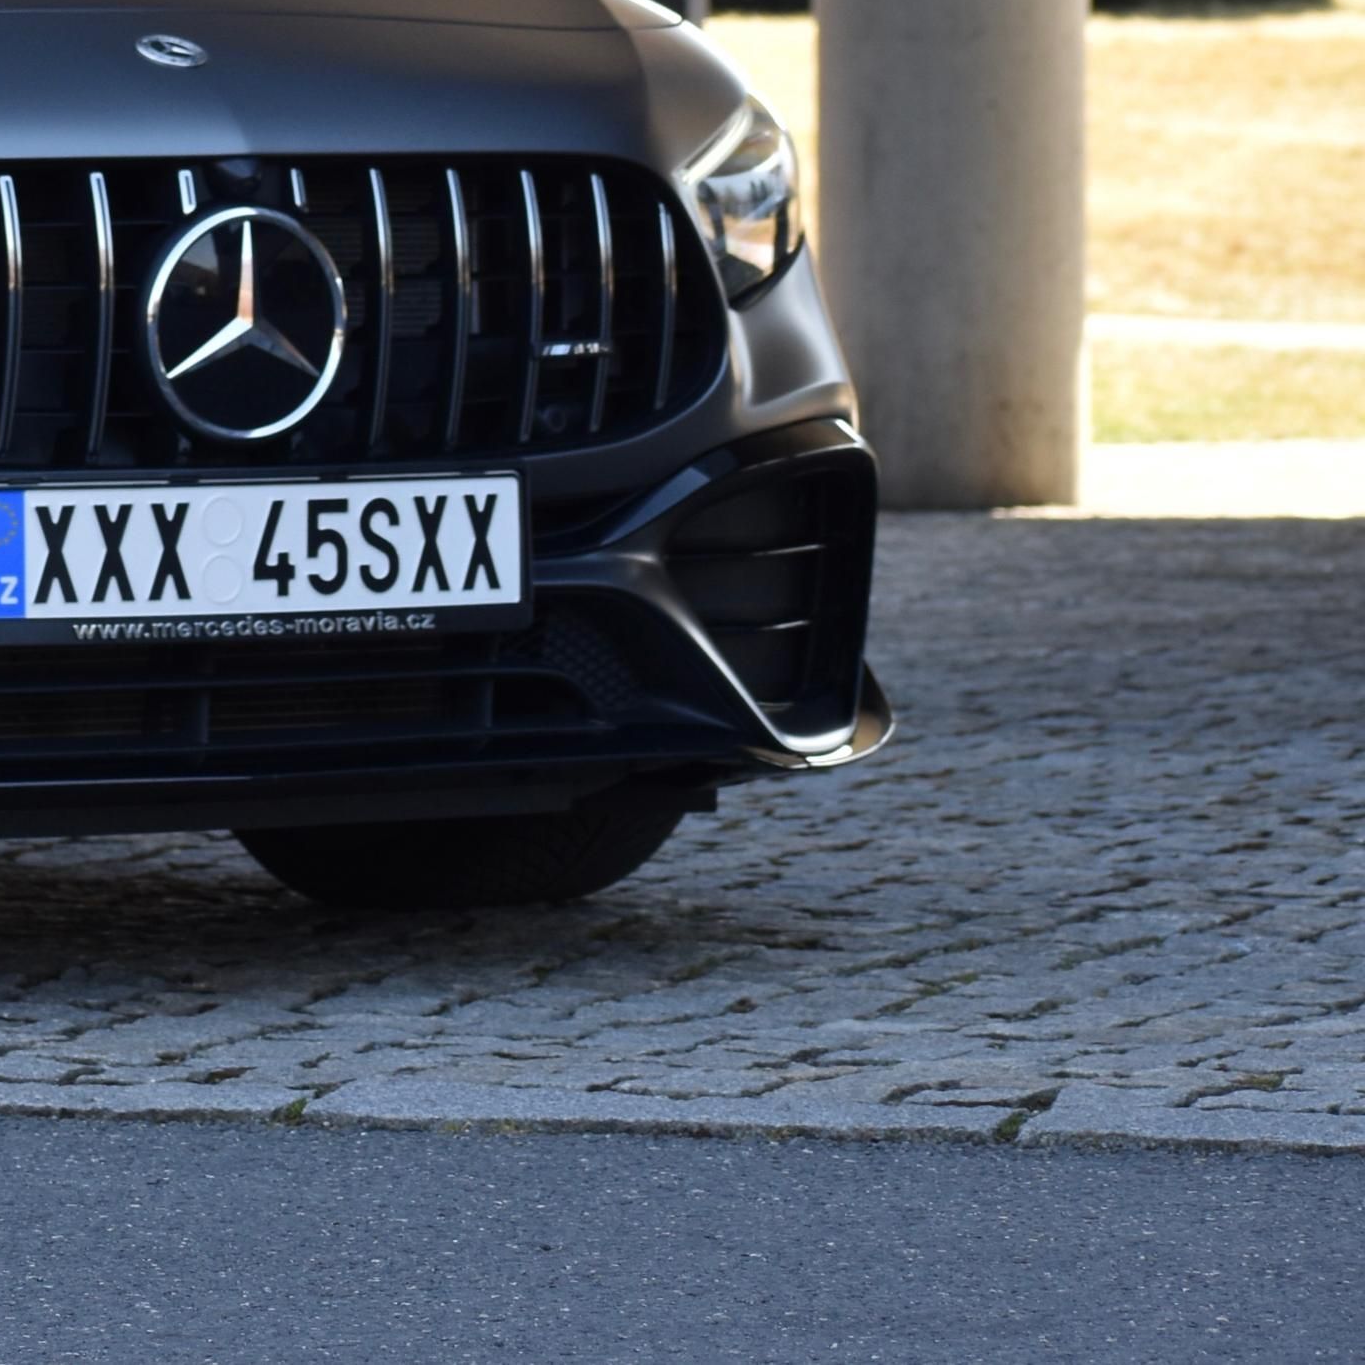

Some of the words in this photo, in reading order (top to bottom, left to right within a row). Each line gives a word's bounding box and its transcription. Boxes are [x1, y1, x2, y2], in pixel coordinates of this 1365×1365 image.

[33, 503, 192, 605] XXX
[252, 494, 501, 597] 45SXX
[72, 611, 437, 641] www.mercedes-moravia.cz
